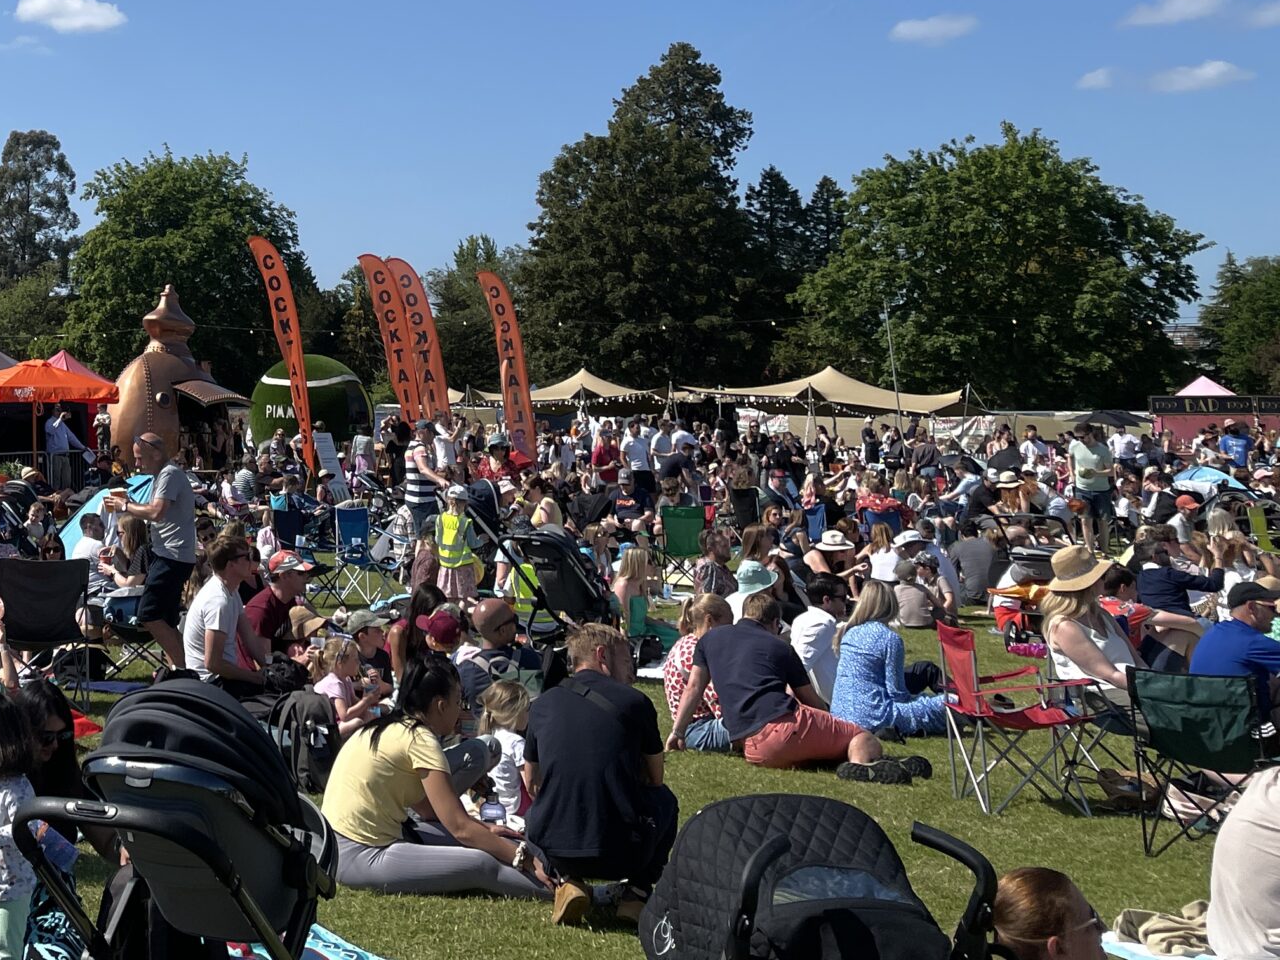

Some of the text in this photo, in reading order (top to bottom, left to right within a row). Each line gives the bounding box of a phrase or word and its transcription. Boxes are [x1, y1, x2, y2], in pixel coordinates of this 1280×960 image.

[373, 270, 416, 424] COCKTAIL
[265, 404, 295, 418] PIMM
[1184, 398, 1220, 413] BAR
